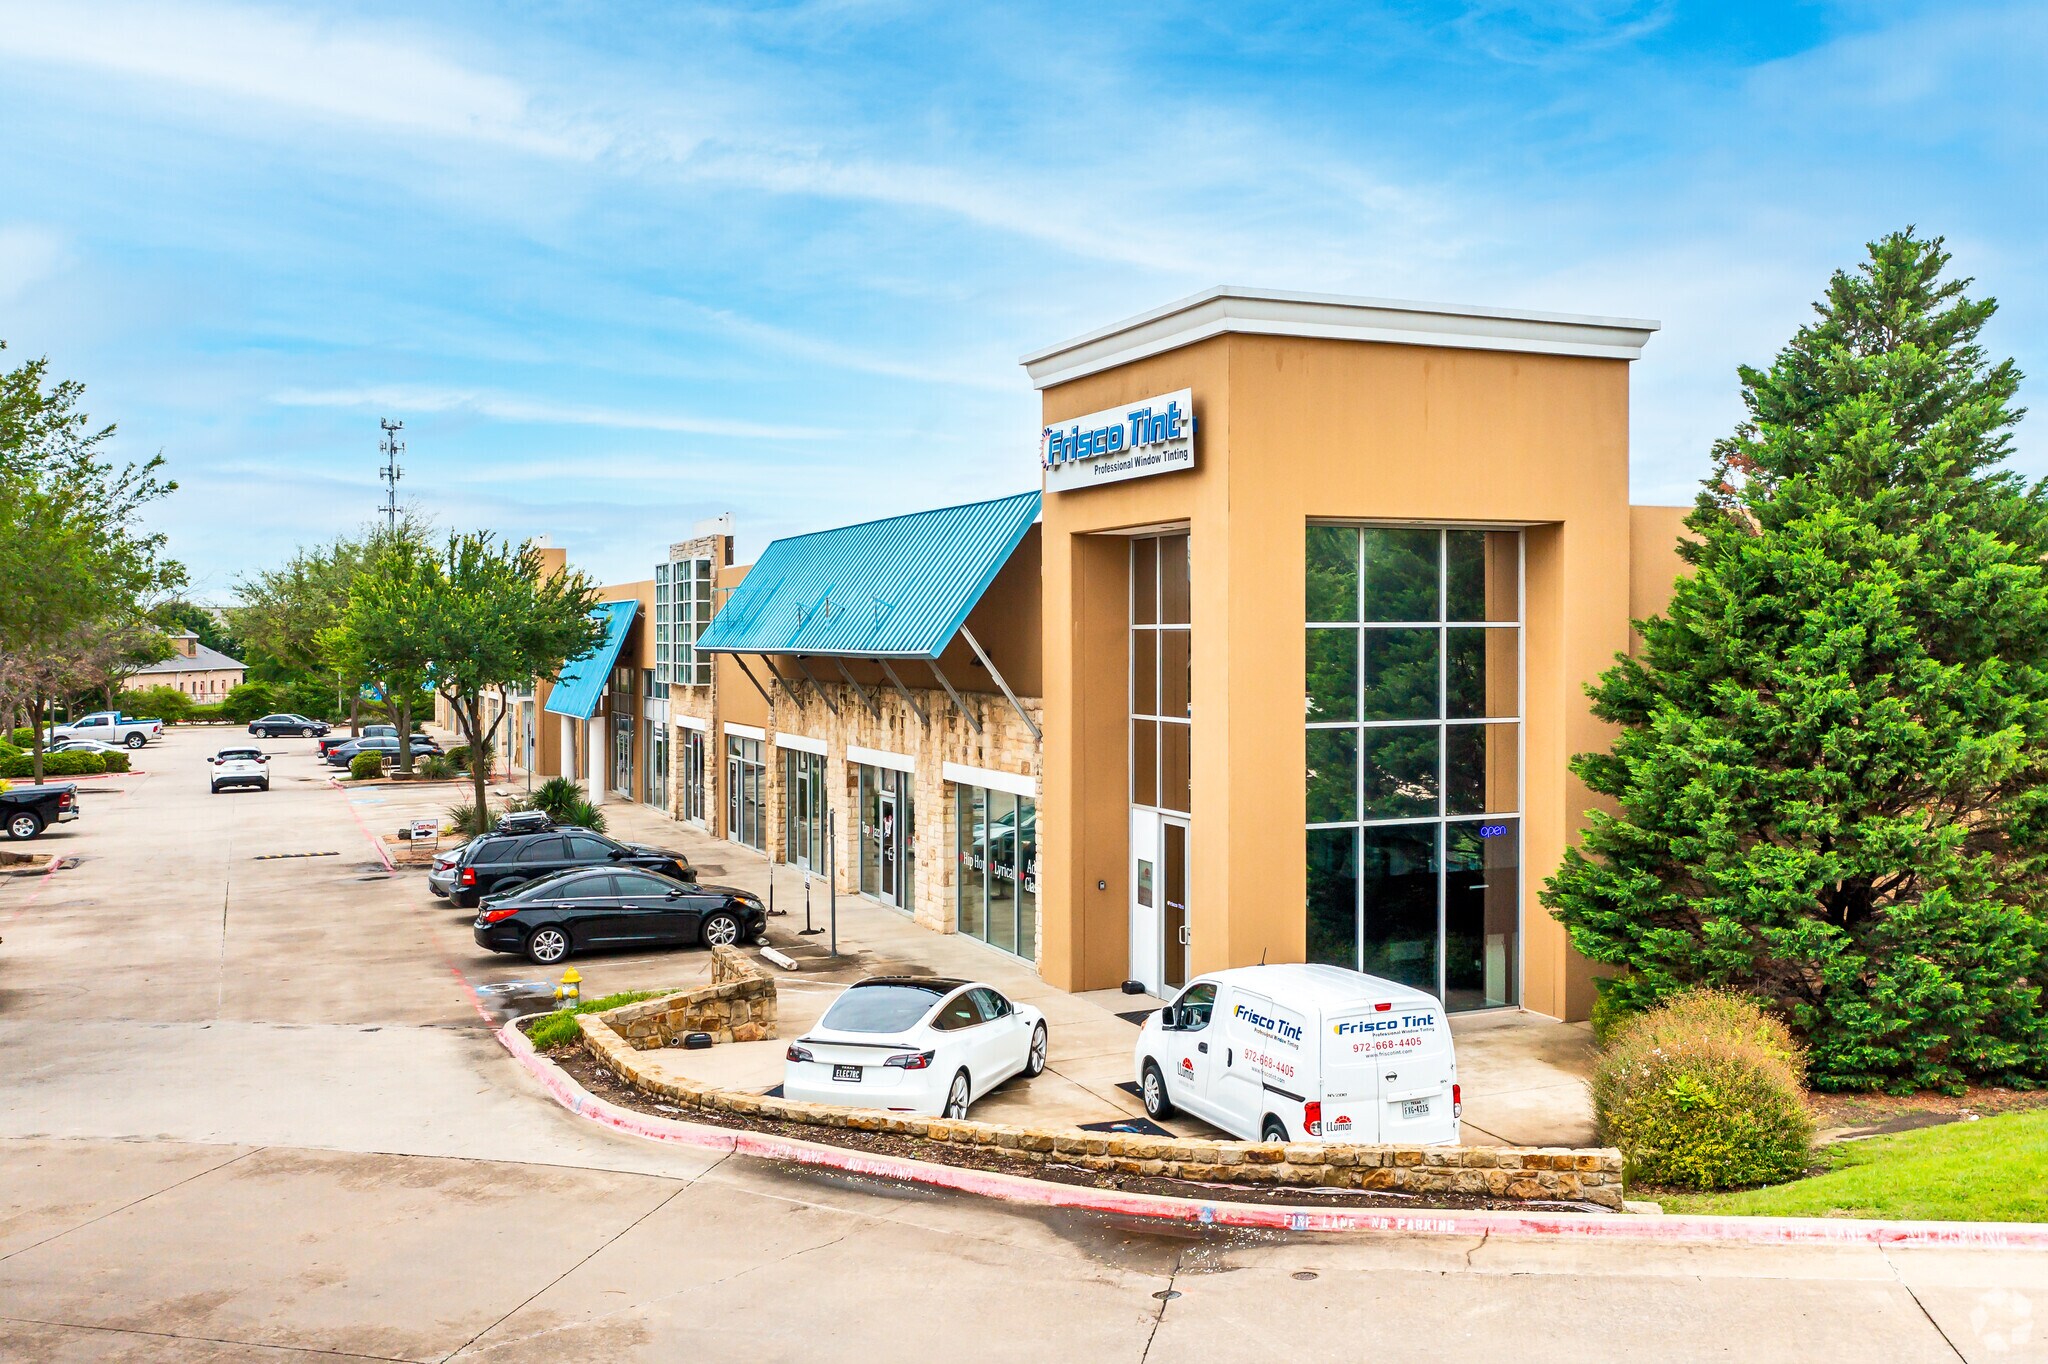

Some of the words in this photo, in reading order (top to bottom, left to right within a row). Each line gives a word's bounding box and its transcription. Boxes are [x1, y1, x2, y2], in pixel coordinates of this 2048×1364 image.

[1048, 422, 1124, 466] Frisco
[1128, 401, 1181, 448] Tint
[1094, 457, 1133, 475] Professional
[1134, 453, 1162, 467] Window
[1163, 449, 1188, 462] Tinting
[1480, 825, 1506, 838] open
[963, 851, 974, 870] Hip
[994, 860, 1015, 879] Lyrical
[1235, 1004, 1275, 1031] Frisco
[1278, 1019, 1303, 1041] Tint
[1338, 1019, 1398, 1035] Frisco
[1402, 1014, 1434, 1028] Tint
[1352, 1037, 1422, 1053] 972-668-4405
[1244, 1048, 1294, 1078] 972-668-4405
[1326, 1121, 1352, 1132] LLumar
[1283, 1214, 1311, 1228] FIRE
[1322, 1215, 1356, 1229] LANE
[1397, 1218, 1456, 1233] PARKING
